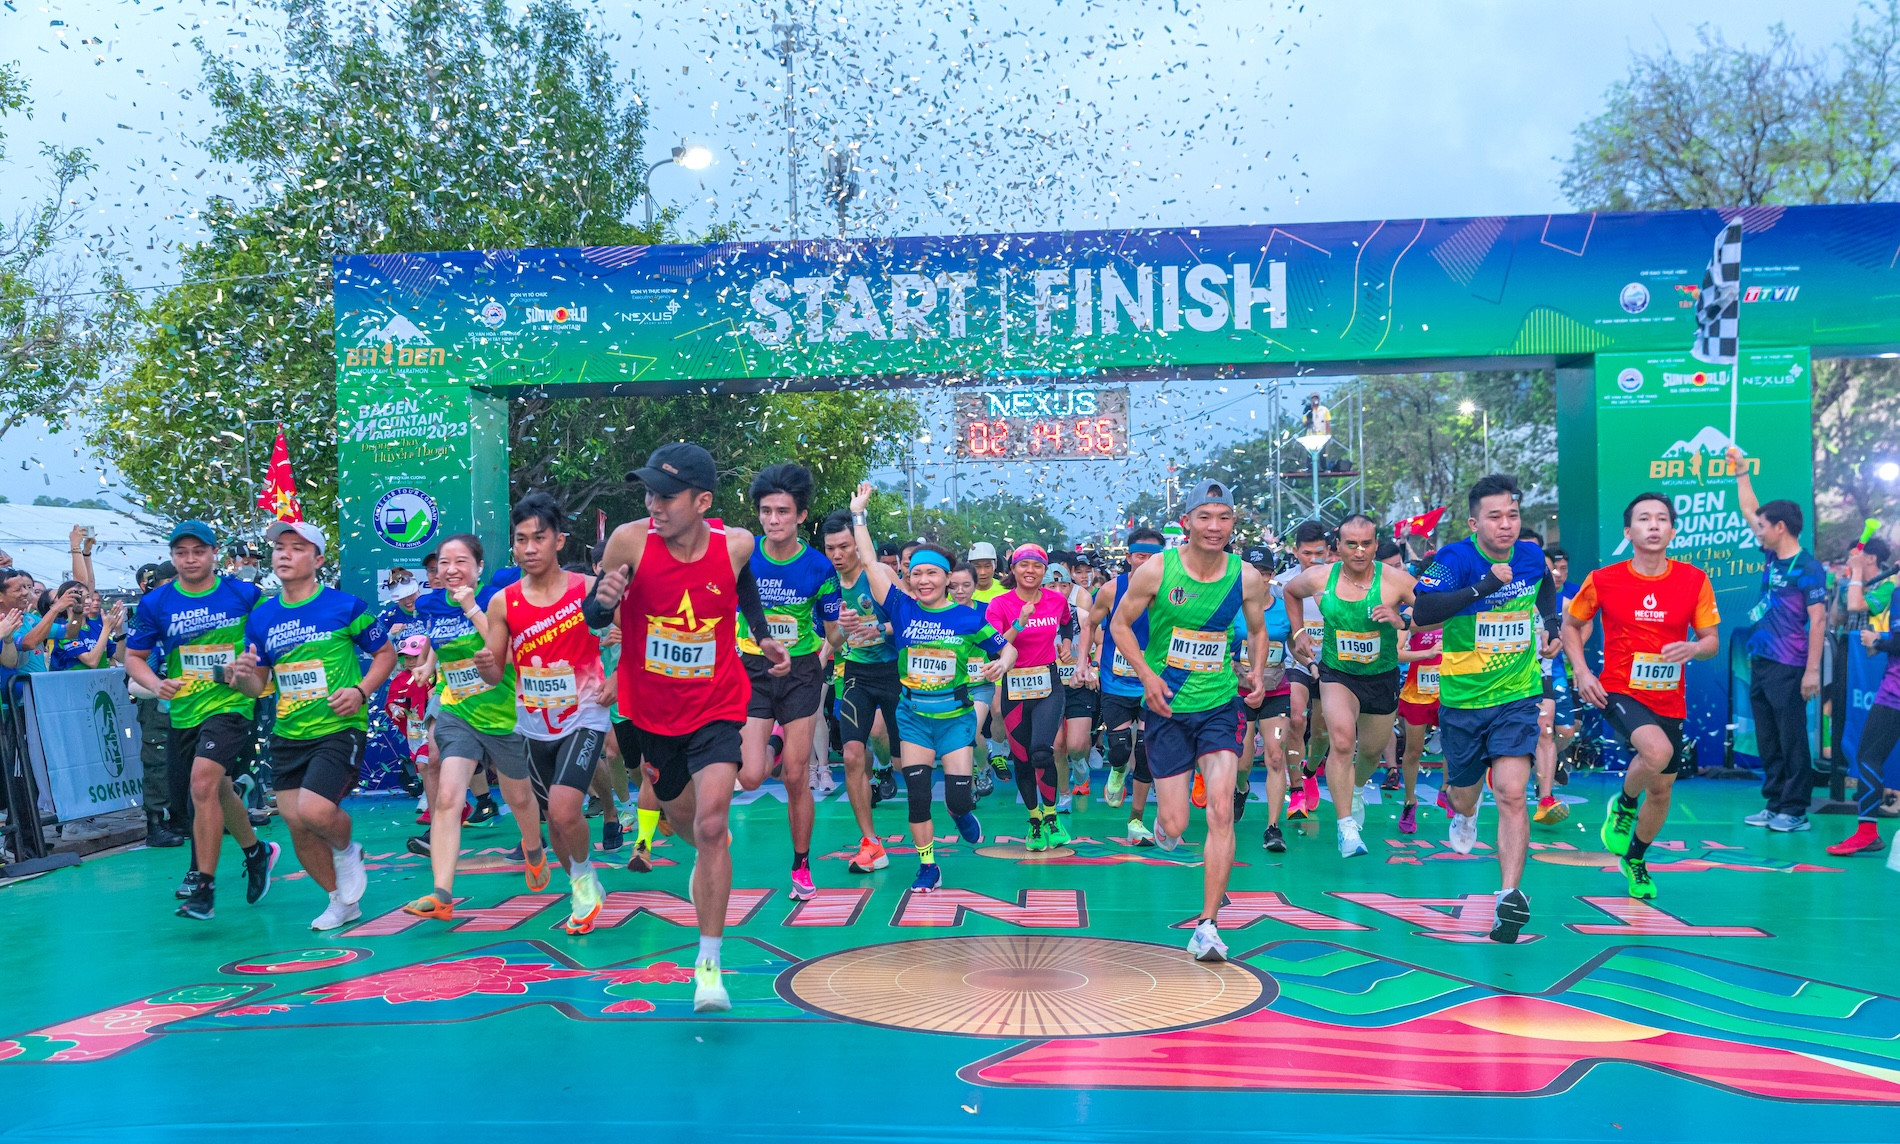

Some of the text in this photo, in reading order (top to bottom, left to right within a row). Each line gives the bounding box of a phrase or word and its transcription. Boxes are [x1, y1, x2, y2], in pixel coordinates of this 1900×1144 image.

[748, 262, 1287, 345] START FINISH
[621, 312, 672, 325] NEXUS
[1742, 375, 1796, 387] NEXUS
[359, 400, 418, 419] BADEN
[985, 391, 1097, 417] NEXUS
[426, 422, 468, 440] 2023
[1516, 584, 1536, 597] 2023
[784, 596, 807, 604] 2023
[171, 607, 209, 623] BADEN
[524, 615, 556, 638] TRÌNH
[555, 598, 582, 620] CHẠY
[1634, 610, 1665, 619] HECTOR
[216, 616, 241, 629] 2023
[268, 619, 301, 637] BADEN
[536, 627, 558, 645] VIỆT
[559, 612, 585, 633] 2023
[910, 619, 941, 629] BADEN
[304, 631, 332, 643] 2023
[1478, 623, 1524, 637] M11115
[652, 640, 704, 663] 11667
[1172, 638, 1219, 656] M11202
[1340, 640, 1373, 653] 11590
[183, 653, 228, 667] M11042
[912, 657, 947, 671] F10746
[279, 671, 318, 687] M10499
[448, 668, 480, 684] F11368
[1636, 665, 1674, 679] 11670
[523, 678, 568, 692] M10554
[1011, 675, 1043, 687] F11218
